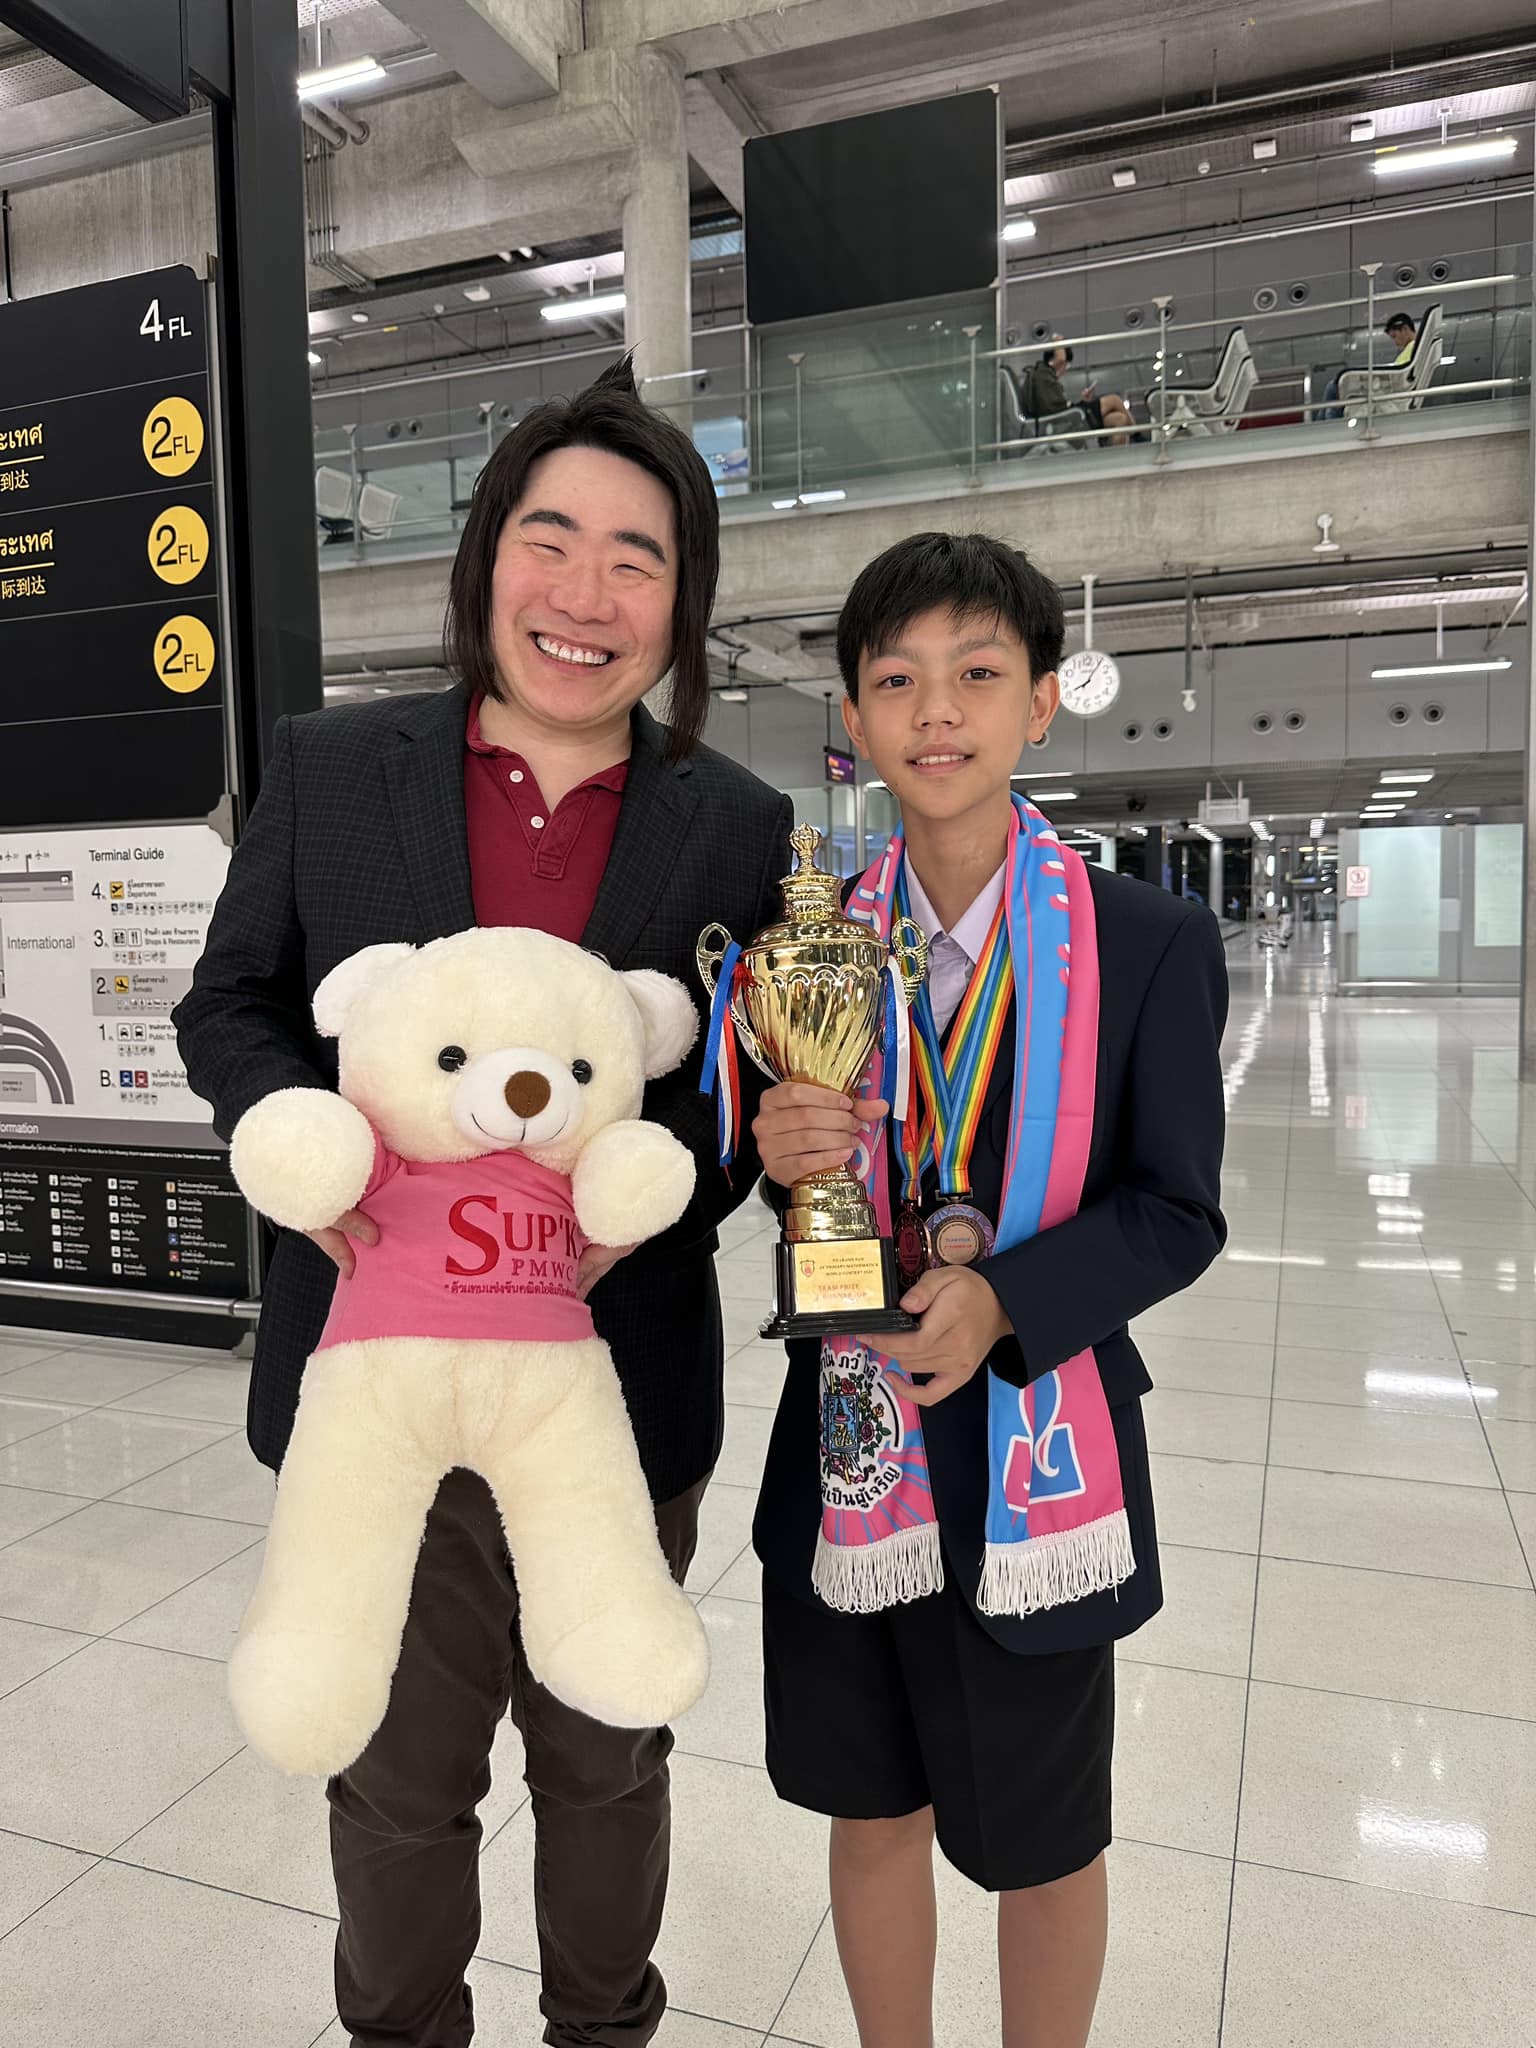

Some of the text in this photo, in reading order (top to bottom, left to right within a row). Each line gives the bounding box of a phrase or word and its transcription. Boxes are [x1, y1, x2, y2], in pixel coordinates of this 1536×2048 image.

[151, 416, 195, 459] 2FL
[156, 524, 200, 567] 2FL
[1, 575, 46, 600] 际到达
[162, 633, 206, 674] 2FL
[89, 848, 165, 862] Terminal Guide
[7, 936, 75, 950] International
[511, 1257, 575, 1283] PMWC
